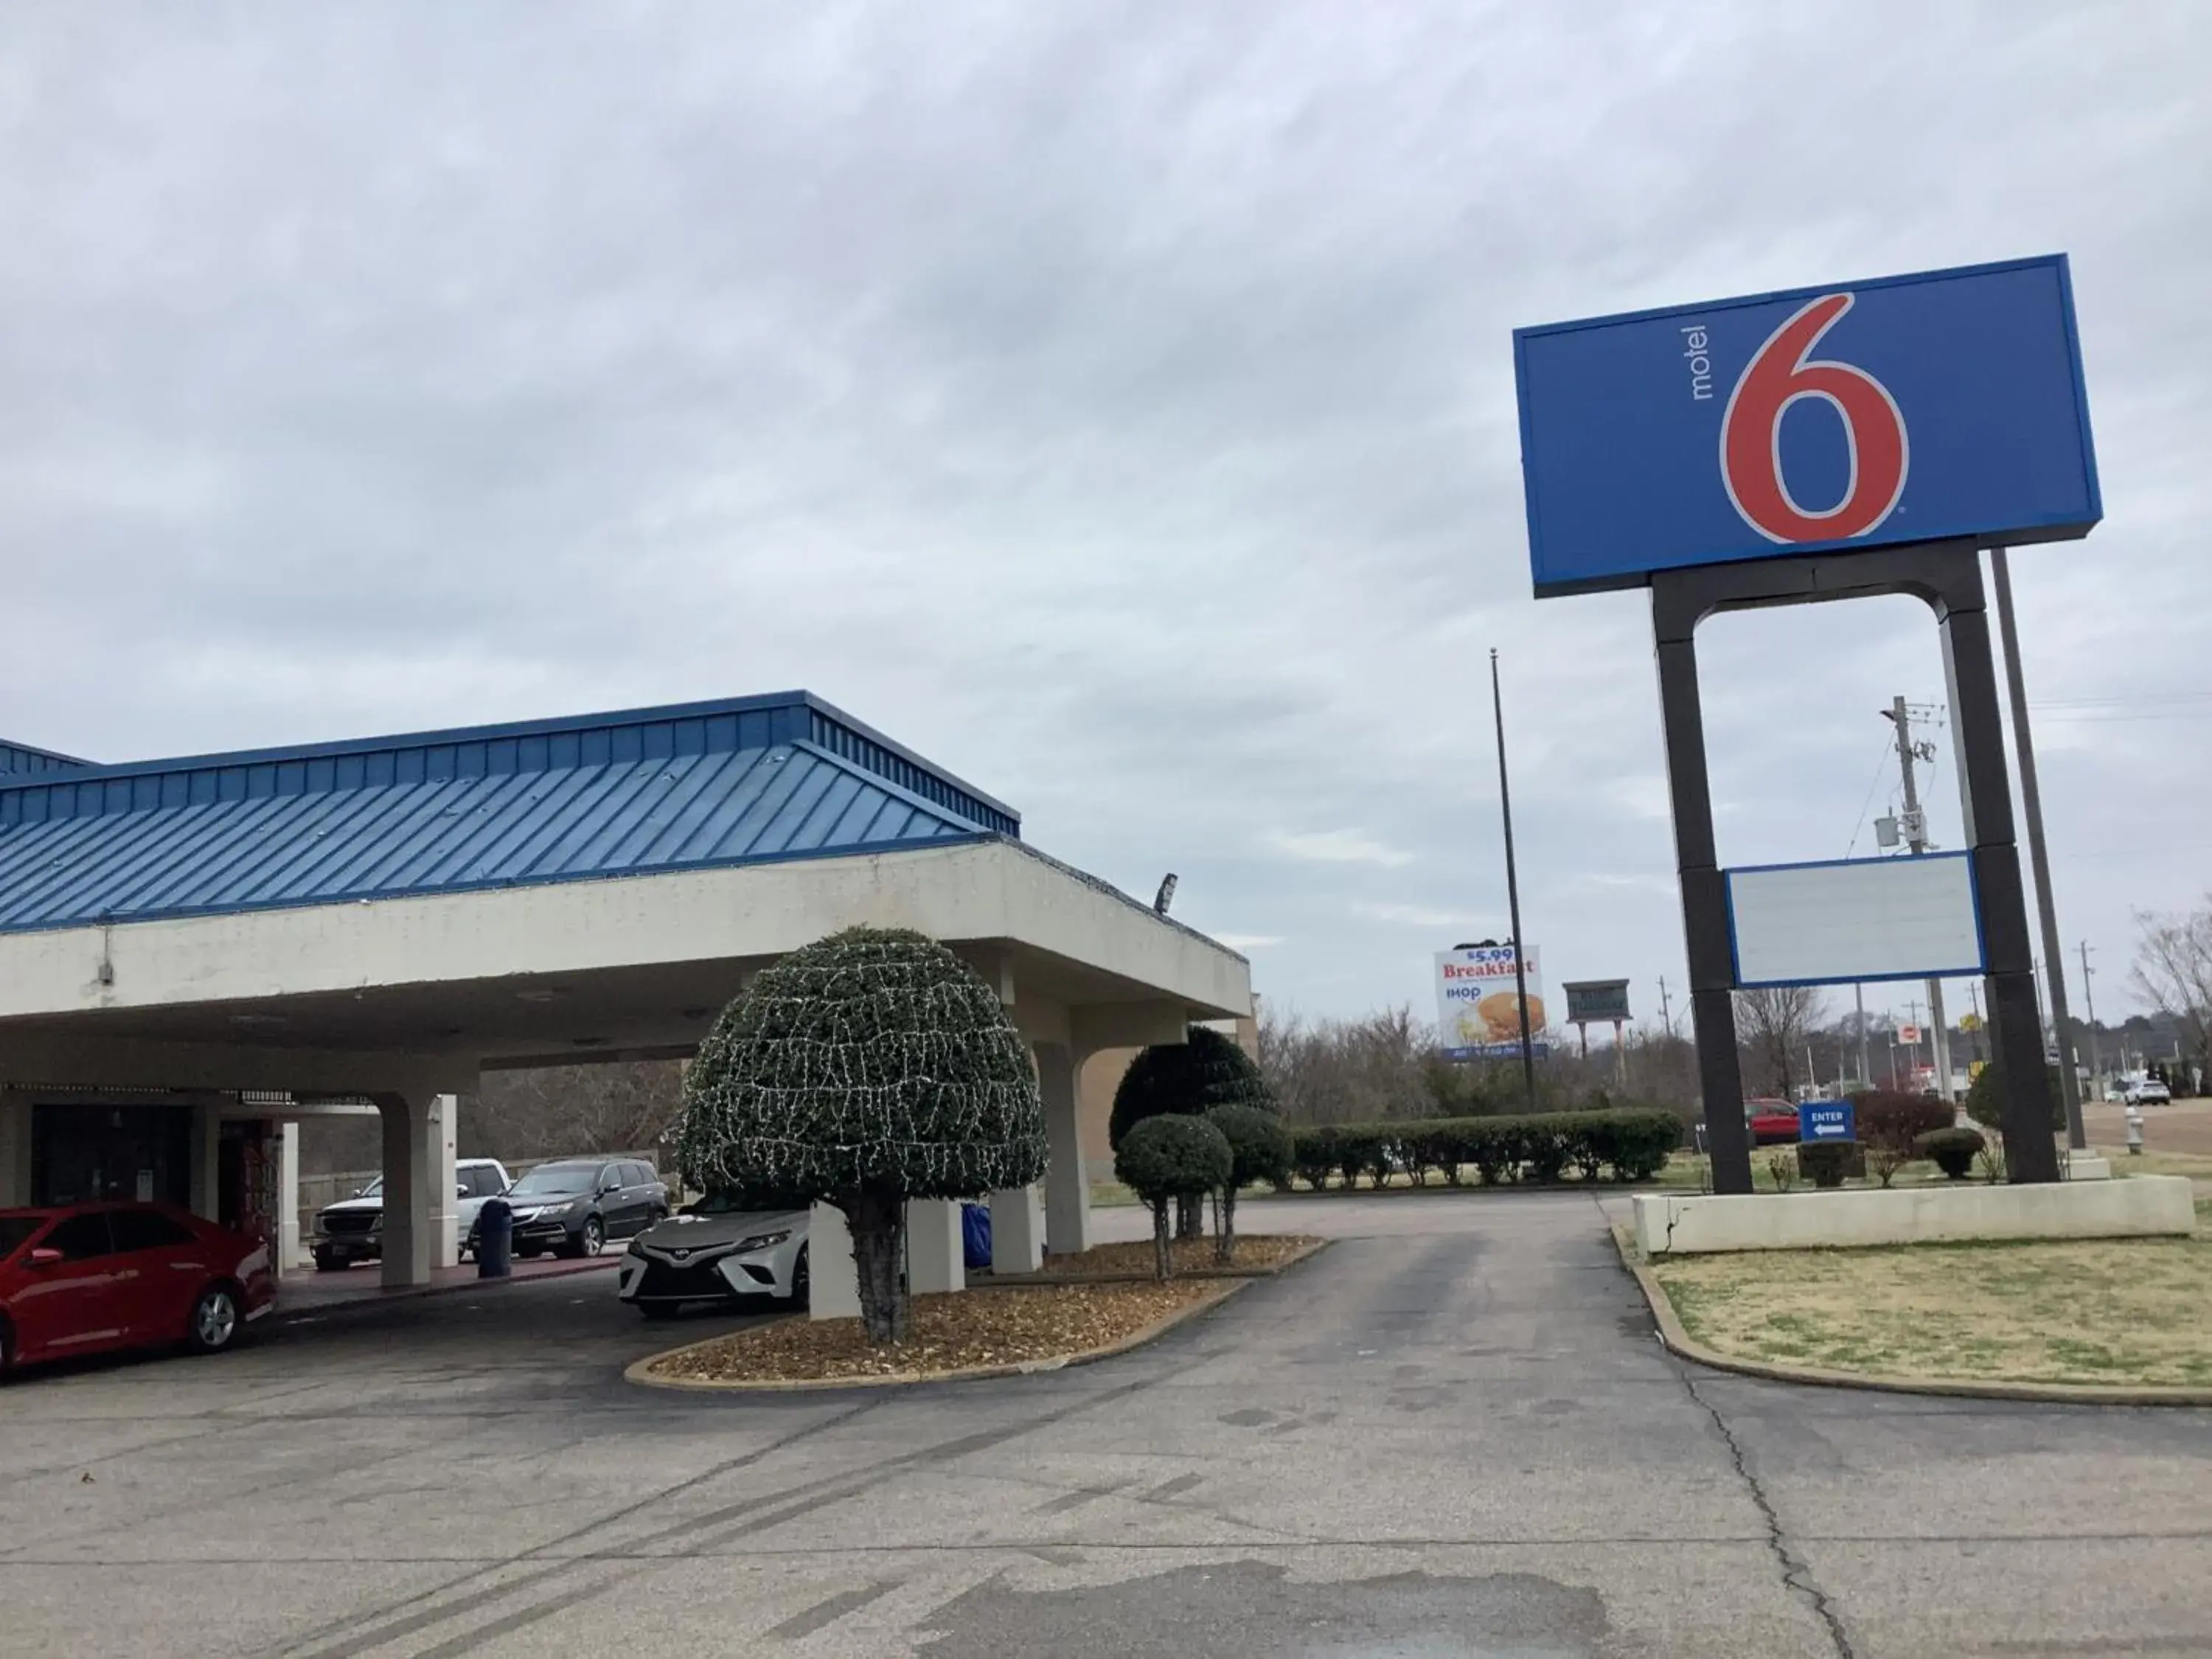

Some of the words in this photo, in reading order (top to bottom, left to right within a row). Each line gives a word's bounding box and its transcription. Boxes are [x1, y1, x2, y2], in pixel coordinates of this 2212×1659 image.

[1680, 325, 1714, 400] motel
[1719, 293, 1909, 544] 6
[1467, 949, 1513, 961] $5.99
[1443, 961, 1534, 978] Breakfat
[1811, 1111, 1843, 1121] ENTER
